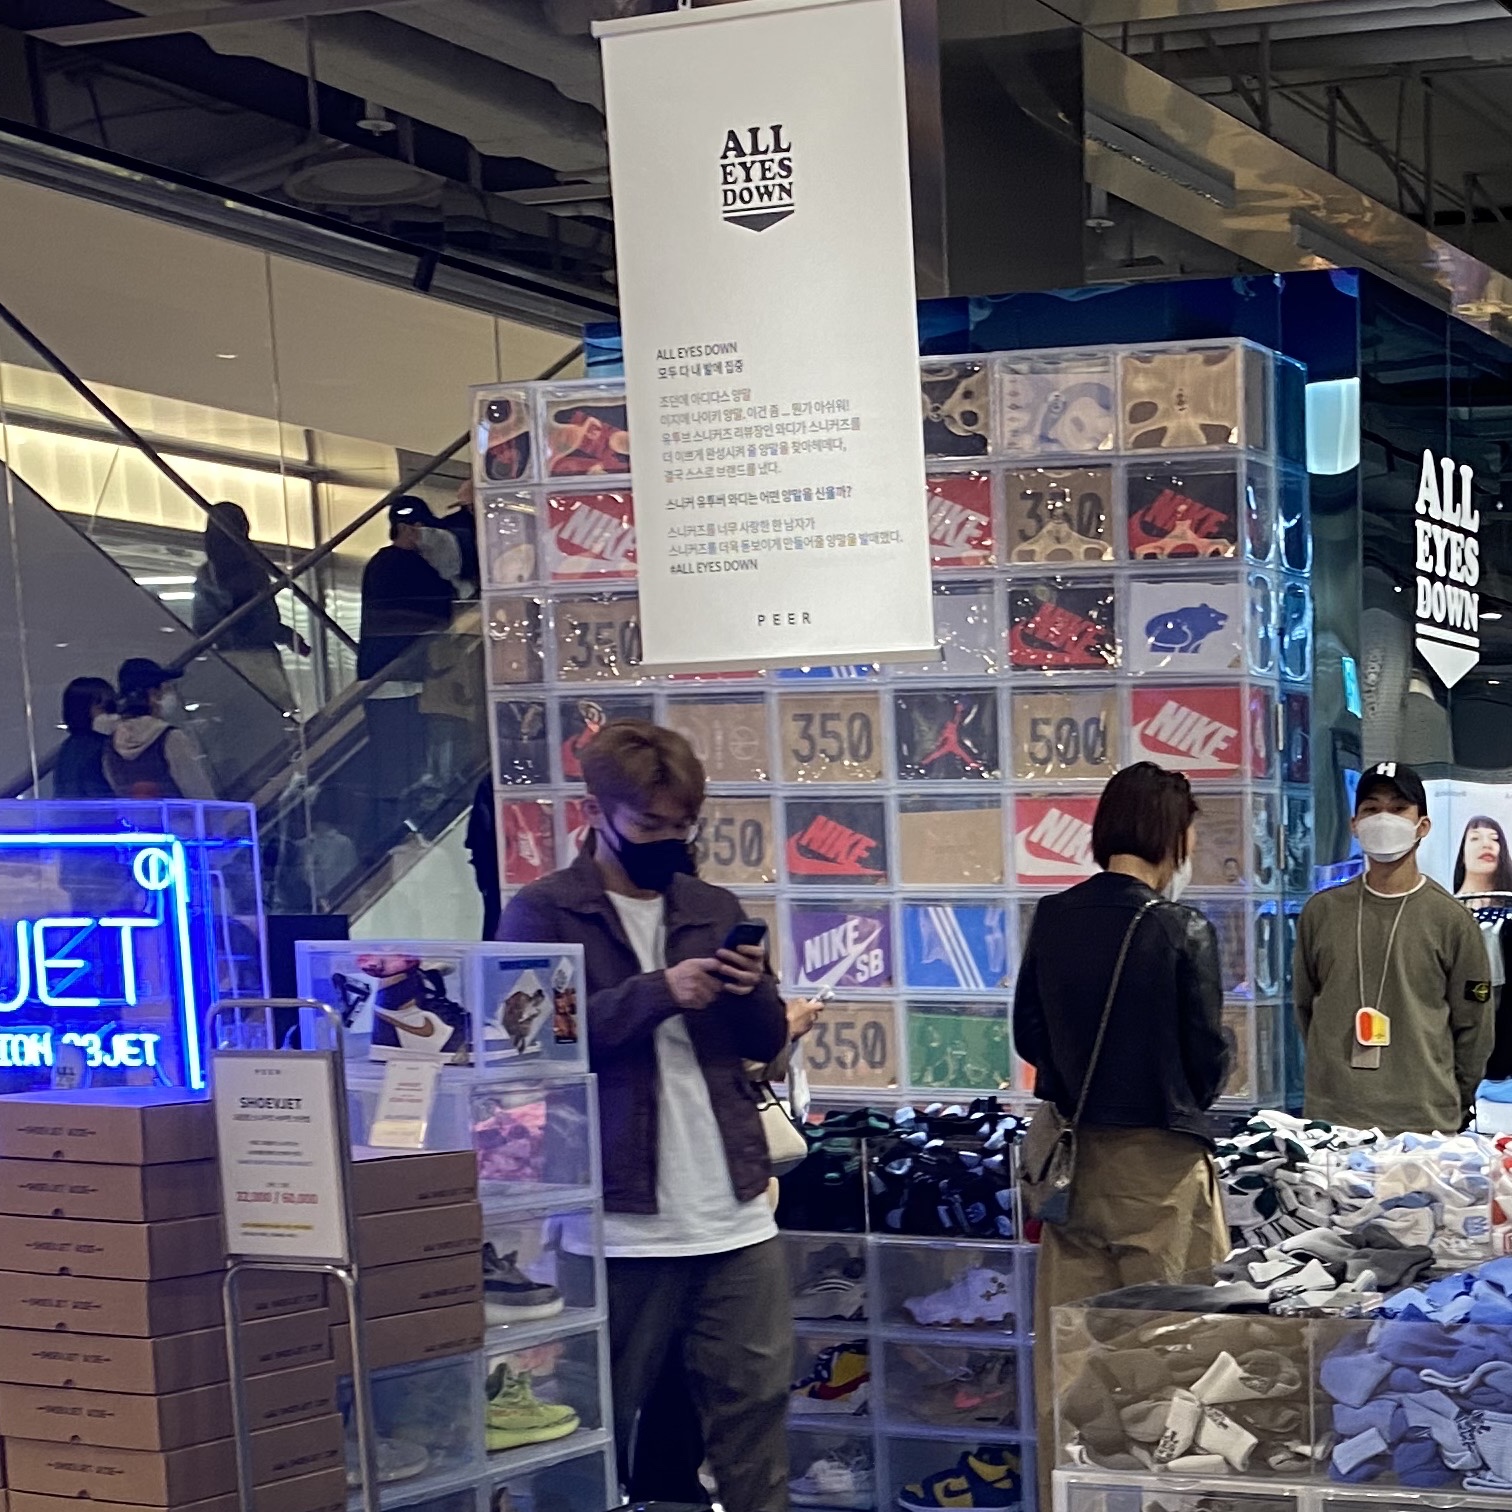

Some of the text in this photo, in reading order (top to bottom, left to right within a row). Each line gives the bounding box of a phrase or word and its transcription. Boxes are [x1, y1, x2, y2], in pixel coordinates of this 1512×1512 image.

[720, 124, 792, 160] ALL
[721, 157, 793, 185] EYES
[723, 182, 794, 207] DOWN
[656, 342, 737, 359] ALL EYES DOWN
[657, 359, 743, 379] 모두 다 내 발에 집중
[690, 390, 730, 404] 아디다스
[692, 409, 721, 424] 나이키
[747, 405, 766, 419] 이건
[692, 428, 732, 441] 스니커즈
[775, 421, 805, 435] 와디가
[662, 451, 672, 463] 더
[685, 466, 713, 479] 스스로
[664, 496, 693, 510] 스니커
[727, 492, 758, 506] 와디는
[1415, 448, 1480, 534] ALL
[717, 521, 737, 535] 너무
[783, 517, 814, 531] 남자가
[670, 559, 758, 574] #ALL EYES DOWN
[1415, 519, 1480, 588] EYES
[1416, 576, 1480, 633] DOWN
[791, 711, 874, 765] 350
[1029, 716, 1107, 766] 500
[1146, 699, 1238, 762] NIKE
[798, 813, 878, 865] NIKE
[1027, 807, 1096, 868] NIK
[805, 919, 860, 974] NIKE
[855, 950, 885, 983] SB
[807, 1020, 888, 1071] 350
